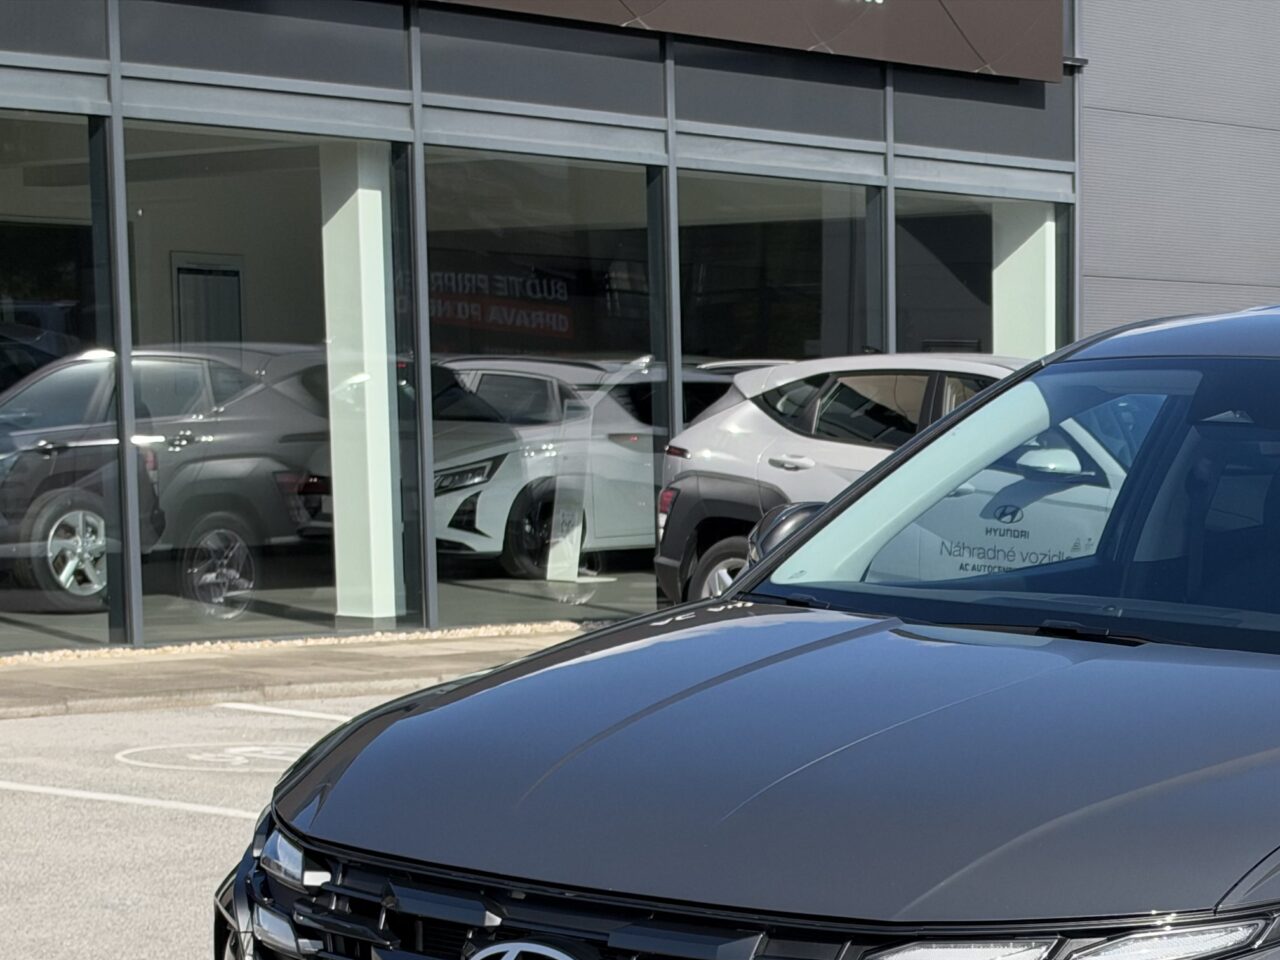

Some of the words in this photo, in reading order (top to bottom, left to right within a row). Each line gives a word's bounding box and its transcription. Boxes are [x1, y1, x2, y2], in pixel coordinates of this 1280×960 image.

[985, 527, 1030, 540] HYUNDAI
[940, 540, 1017, 563] Náhradné
[959, 563, 970, 572] AC
[971, 564, 1019, 574] AUTOCEN
